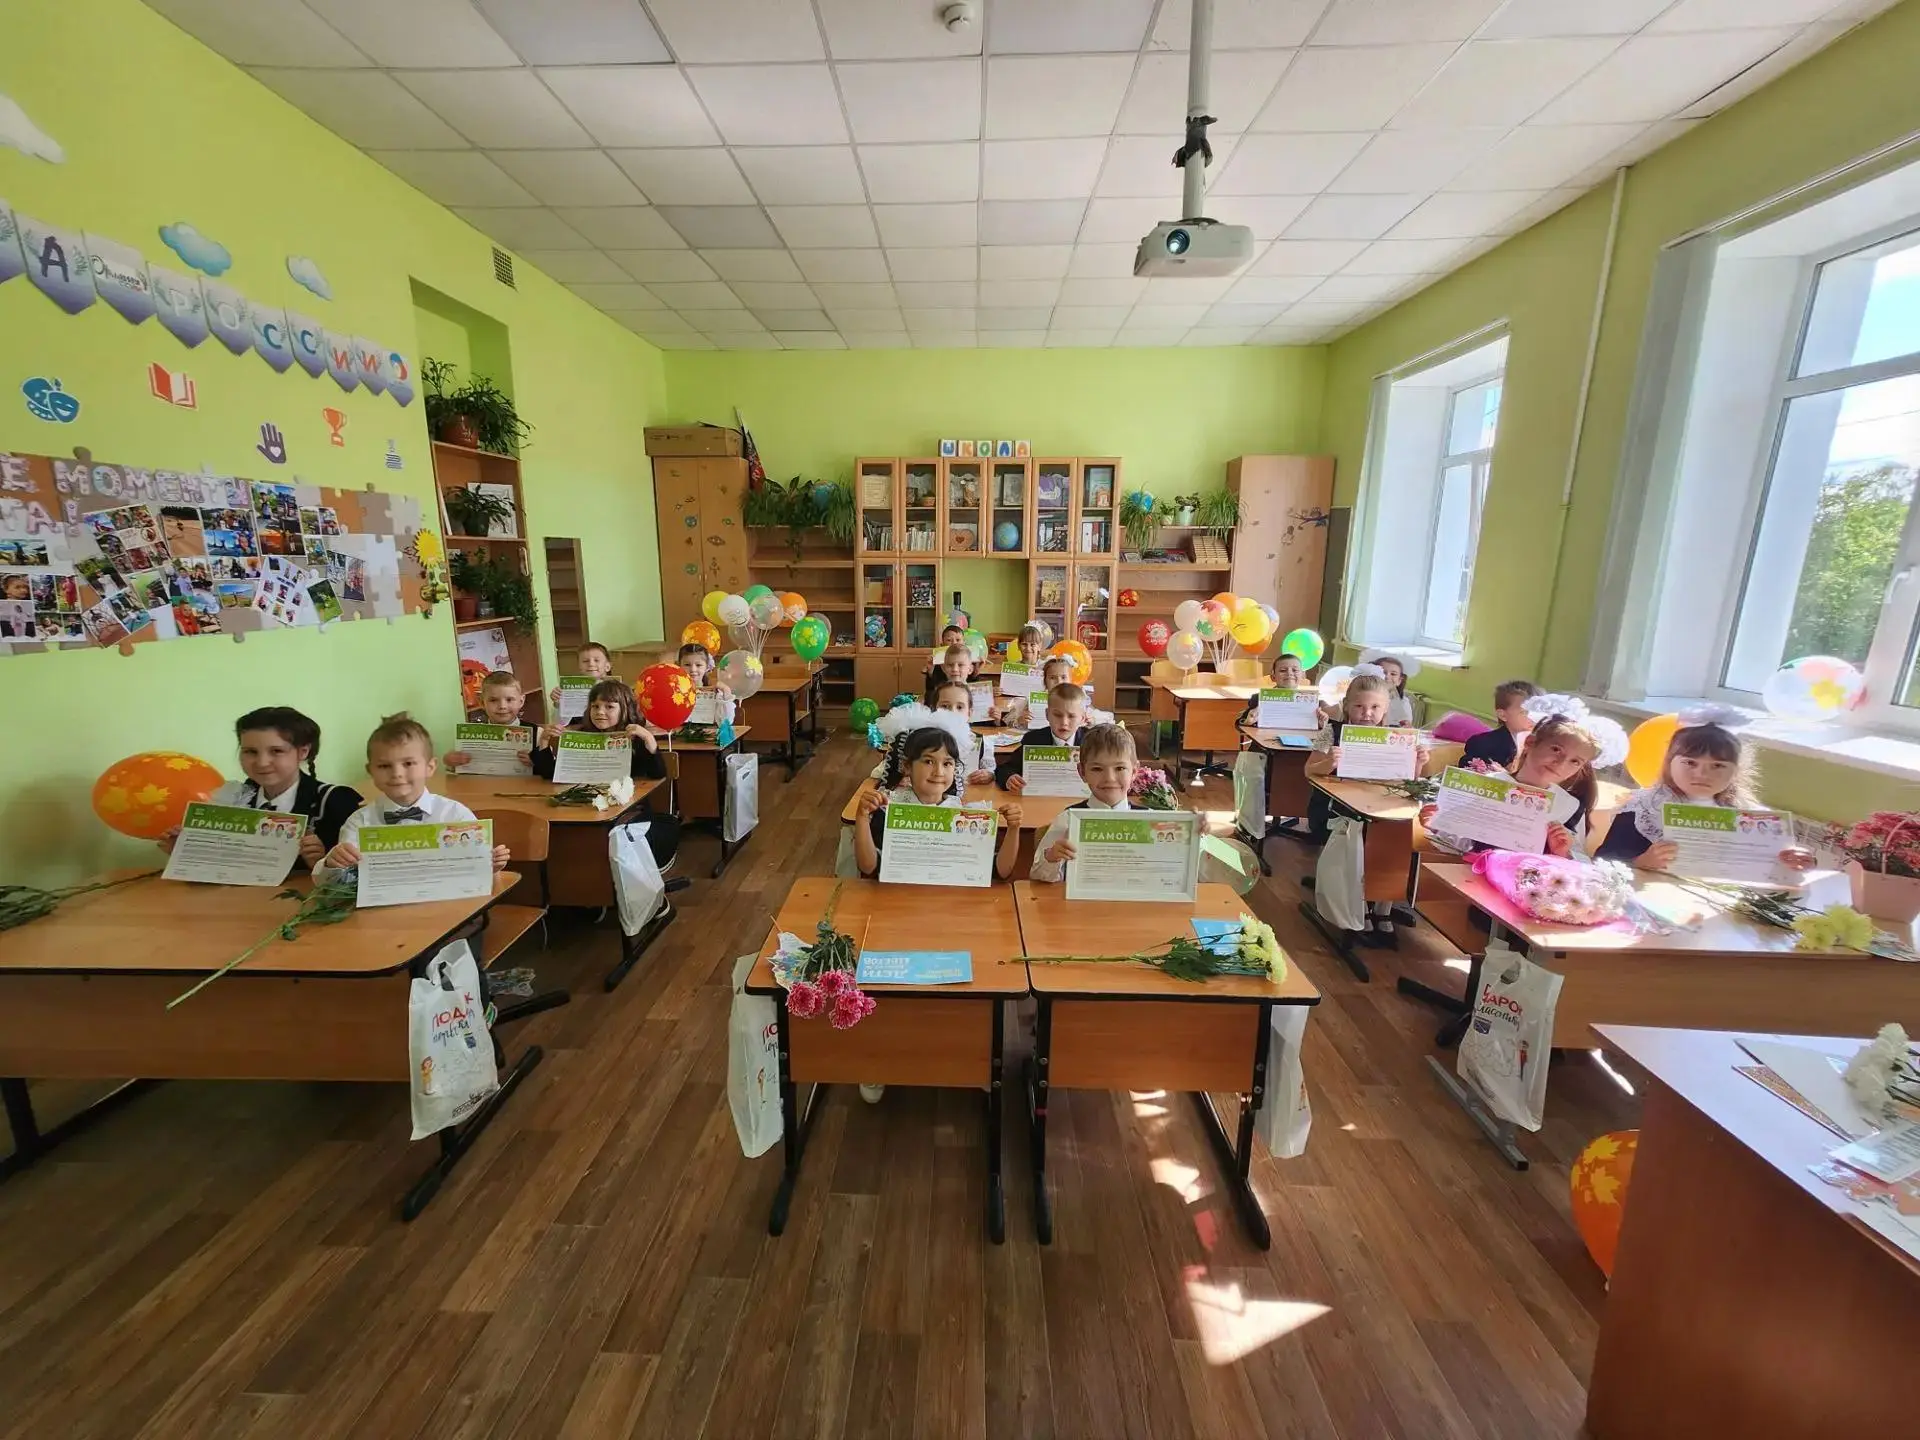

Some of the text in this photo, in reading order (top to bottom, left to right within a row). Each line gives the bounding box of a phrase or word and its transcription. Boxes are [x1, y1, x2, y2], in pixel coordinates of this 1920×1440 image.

[941, 440, 1030, 457] ШКОЛА
[459, 732, 499, 740] ГРАМОТА
[1345, 735, 1383, 744] ГРАМОТА
[564, 741, 602, 750] ГРАМОТА
[1448, 780, 1500, 800] ГРАМОТА
[190, 818, 249, 833] ГРАМОТА
[892, 819, 945, 831] ГРАМОТА
[1670, 818, 1728, 830] ГРАМОТА
[1085, 831, 1138, 841] ГРАМОТА
[367, 840, 431, 851] ГРАМОТА
